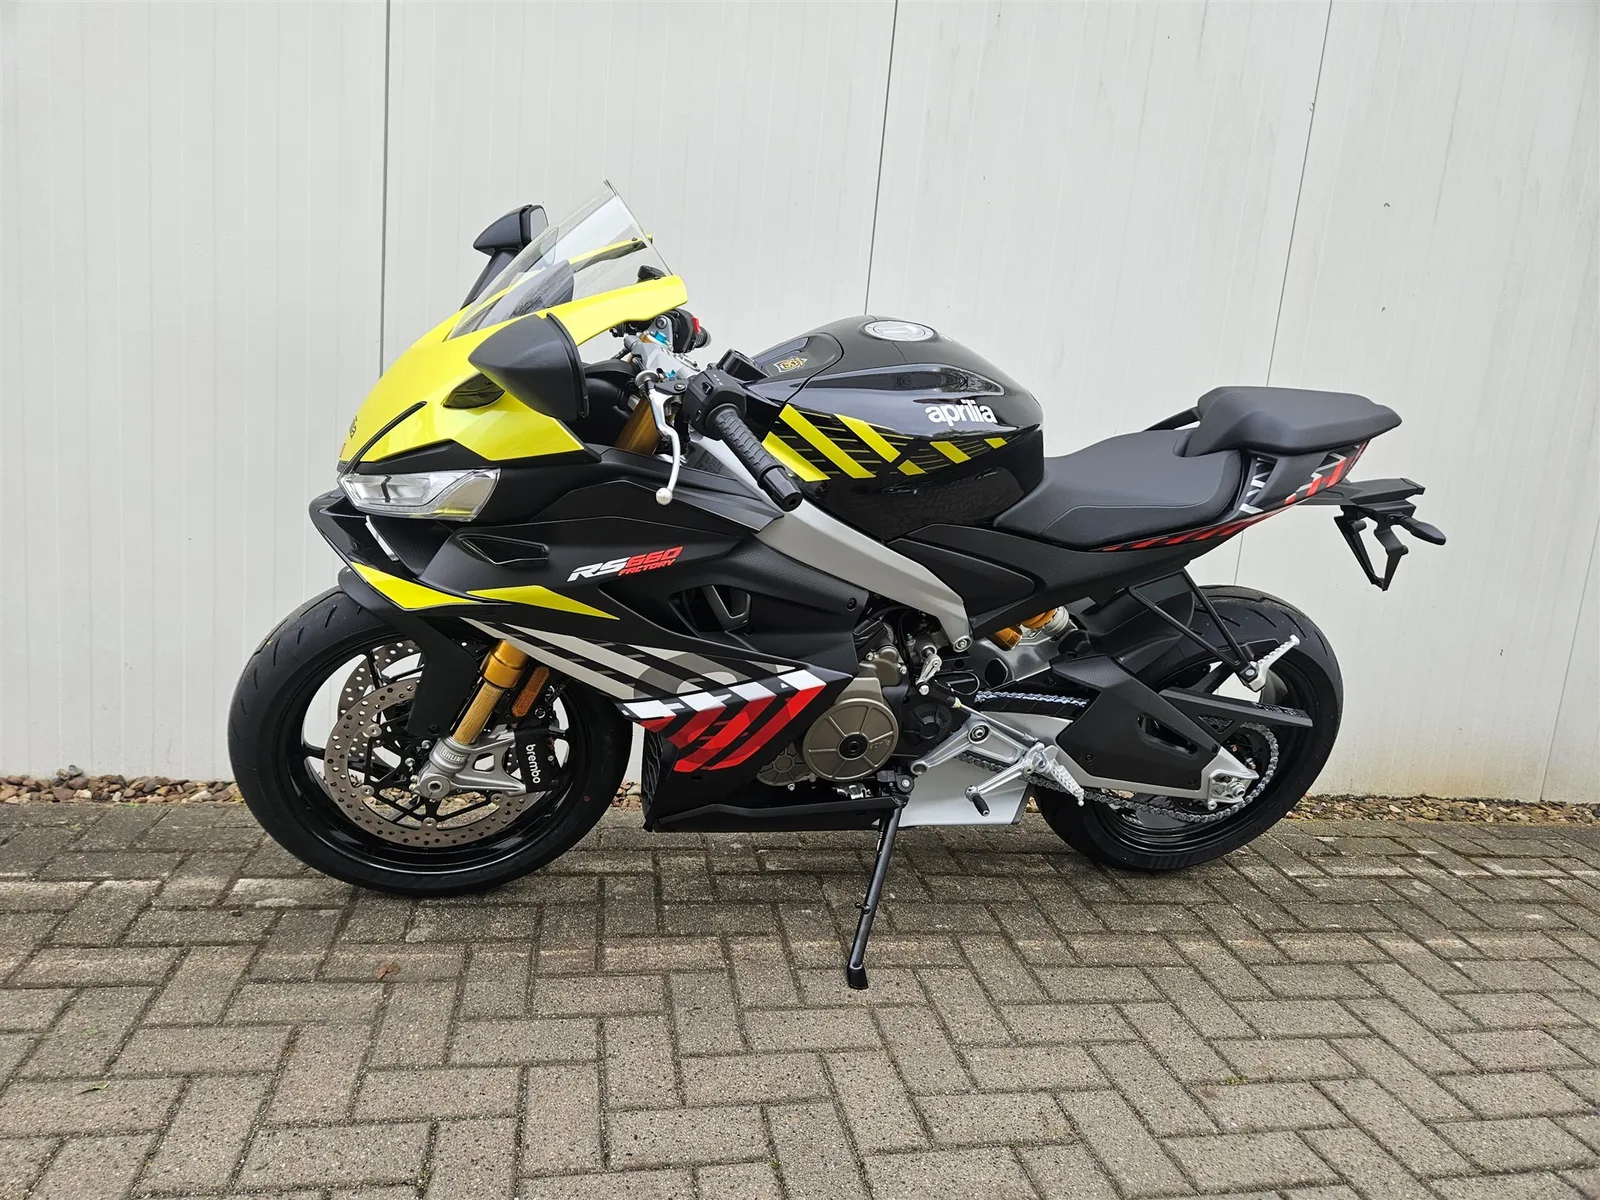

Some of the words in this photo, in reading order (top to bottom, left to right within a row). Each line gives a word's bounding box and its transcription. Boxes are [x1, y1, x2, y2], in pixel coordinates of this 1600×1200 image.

[925, 399, 998, 427] aprilia
[618, 559, 676, 576] FACTORY
[525, 743, 542, 784] brembo
